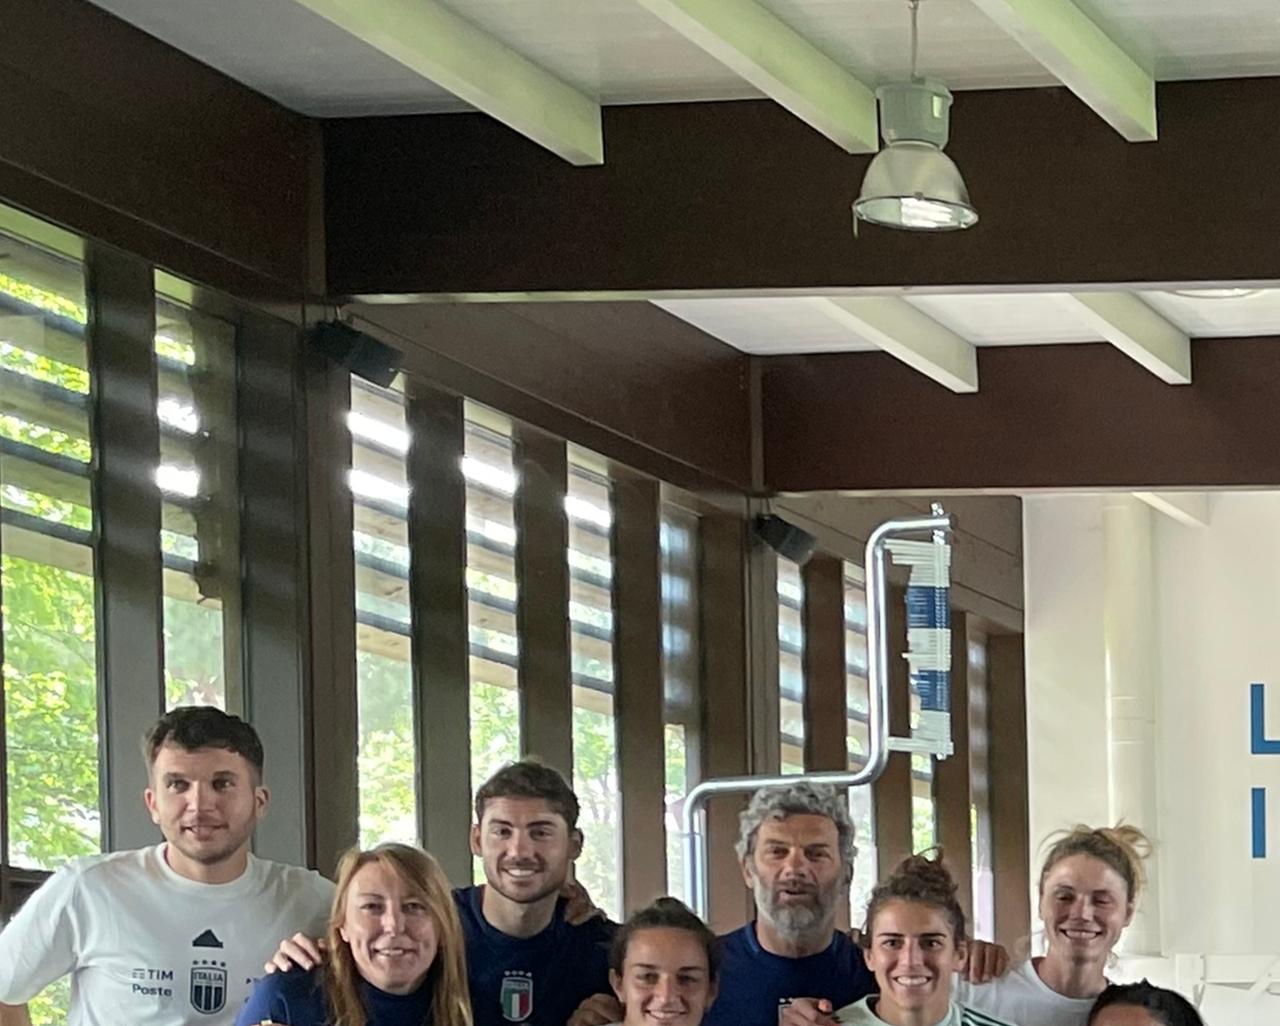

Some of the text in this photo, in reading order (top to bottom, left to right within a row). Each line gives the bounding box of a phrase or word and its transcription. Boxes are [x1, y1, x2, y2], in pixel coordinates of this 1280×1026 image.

[147, 968, 174, 981] TIM
[193, 971, 225, 982] ITALIA
[131, 982, 173, 998] Poste
